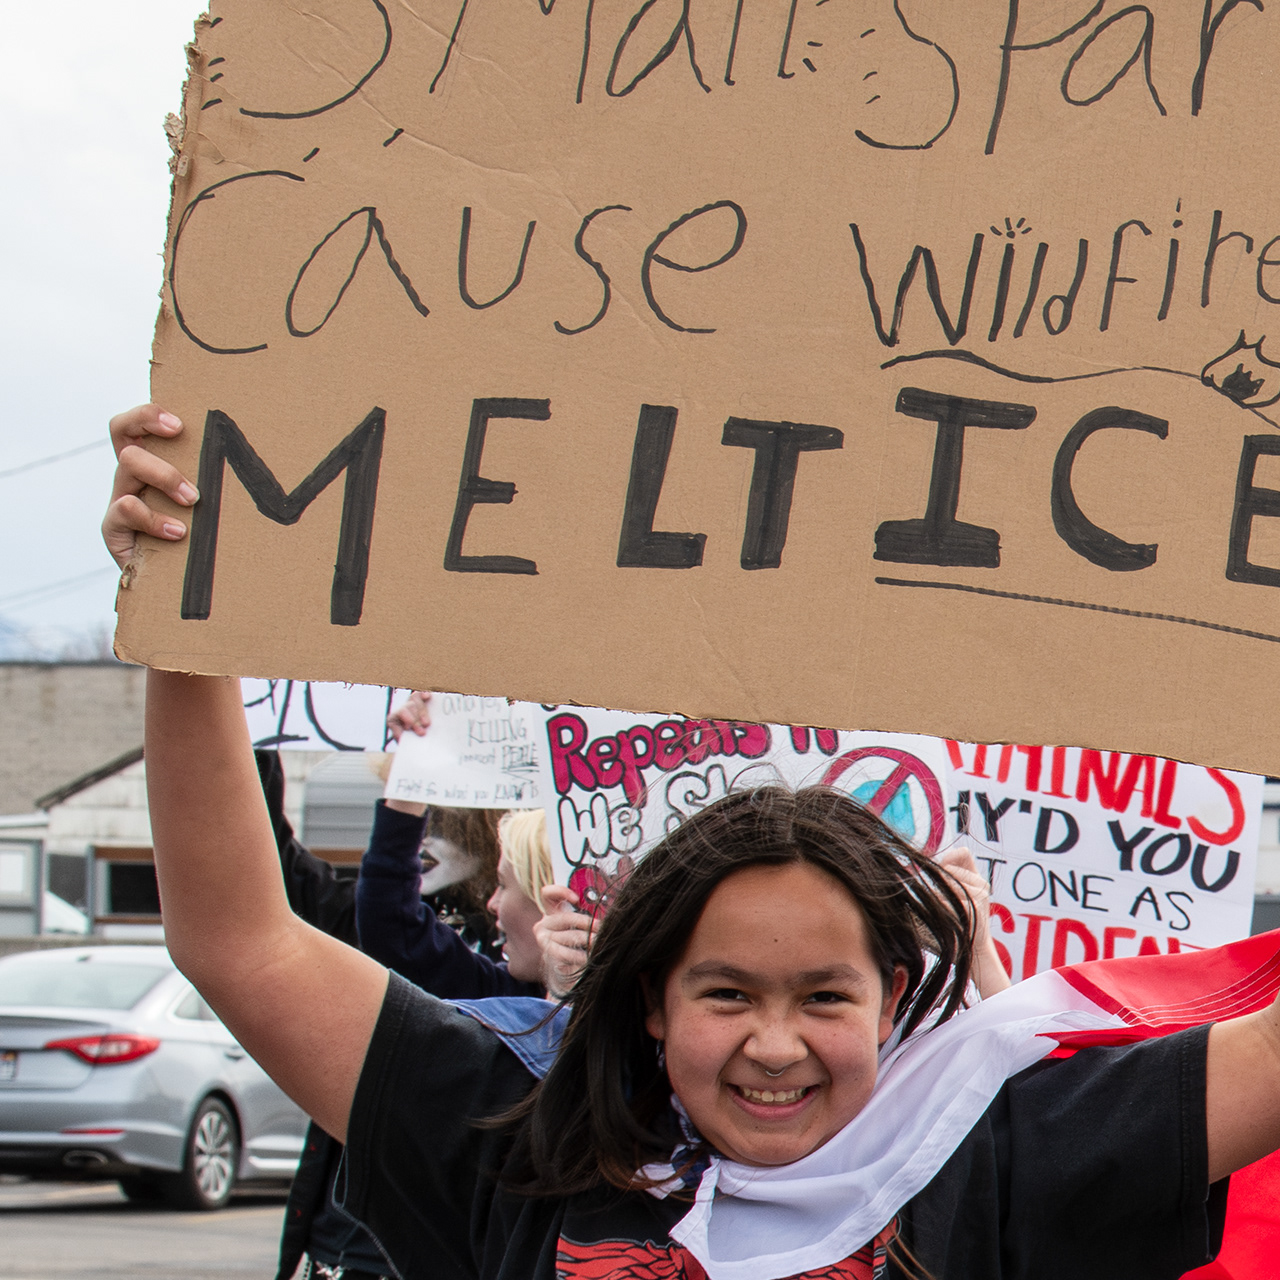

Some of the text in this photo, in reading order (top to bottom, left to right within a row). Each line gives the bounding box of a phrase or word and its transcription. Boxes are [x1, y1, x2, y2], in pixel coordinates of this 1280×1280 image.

[170, 169, 747, 354] Cause
[181, 397, 844, 625] MELT
[1012, 862, 1114, 913] ONE
[1129, 886, 1194, 931] AS
[1107, 819, 1241, 893] YOU
